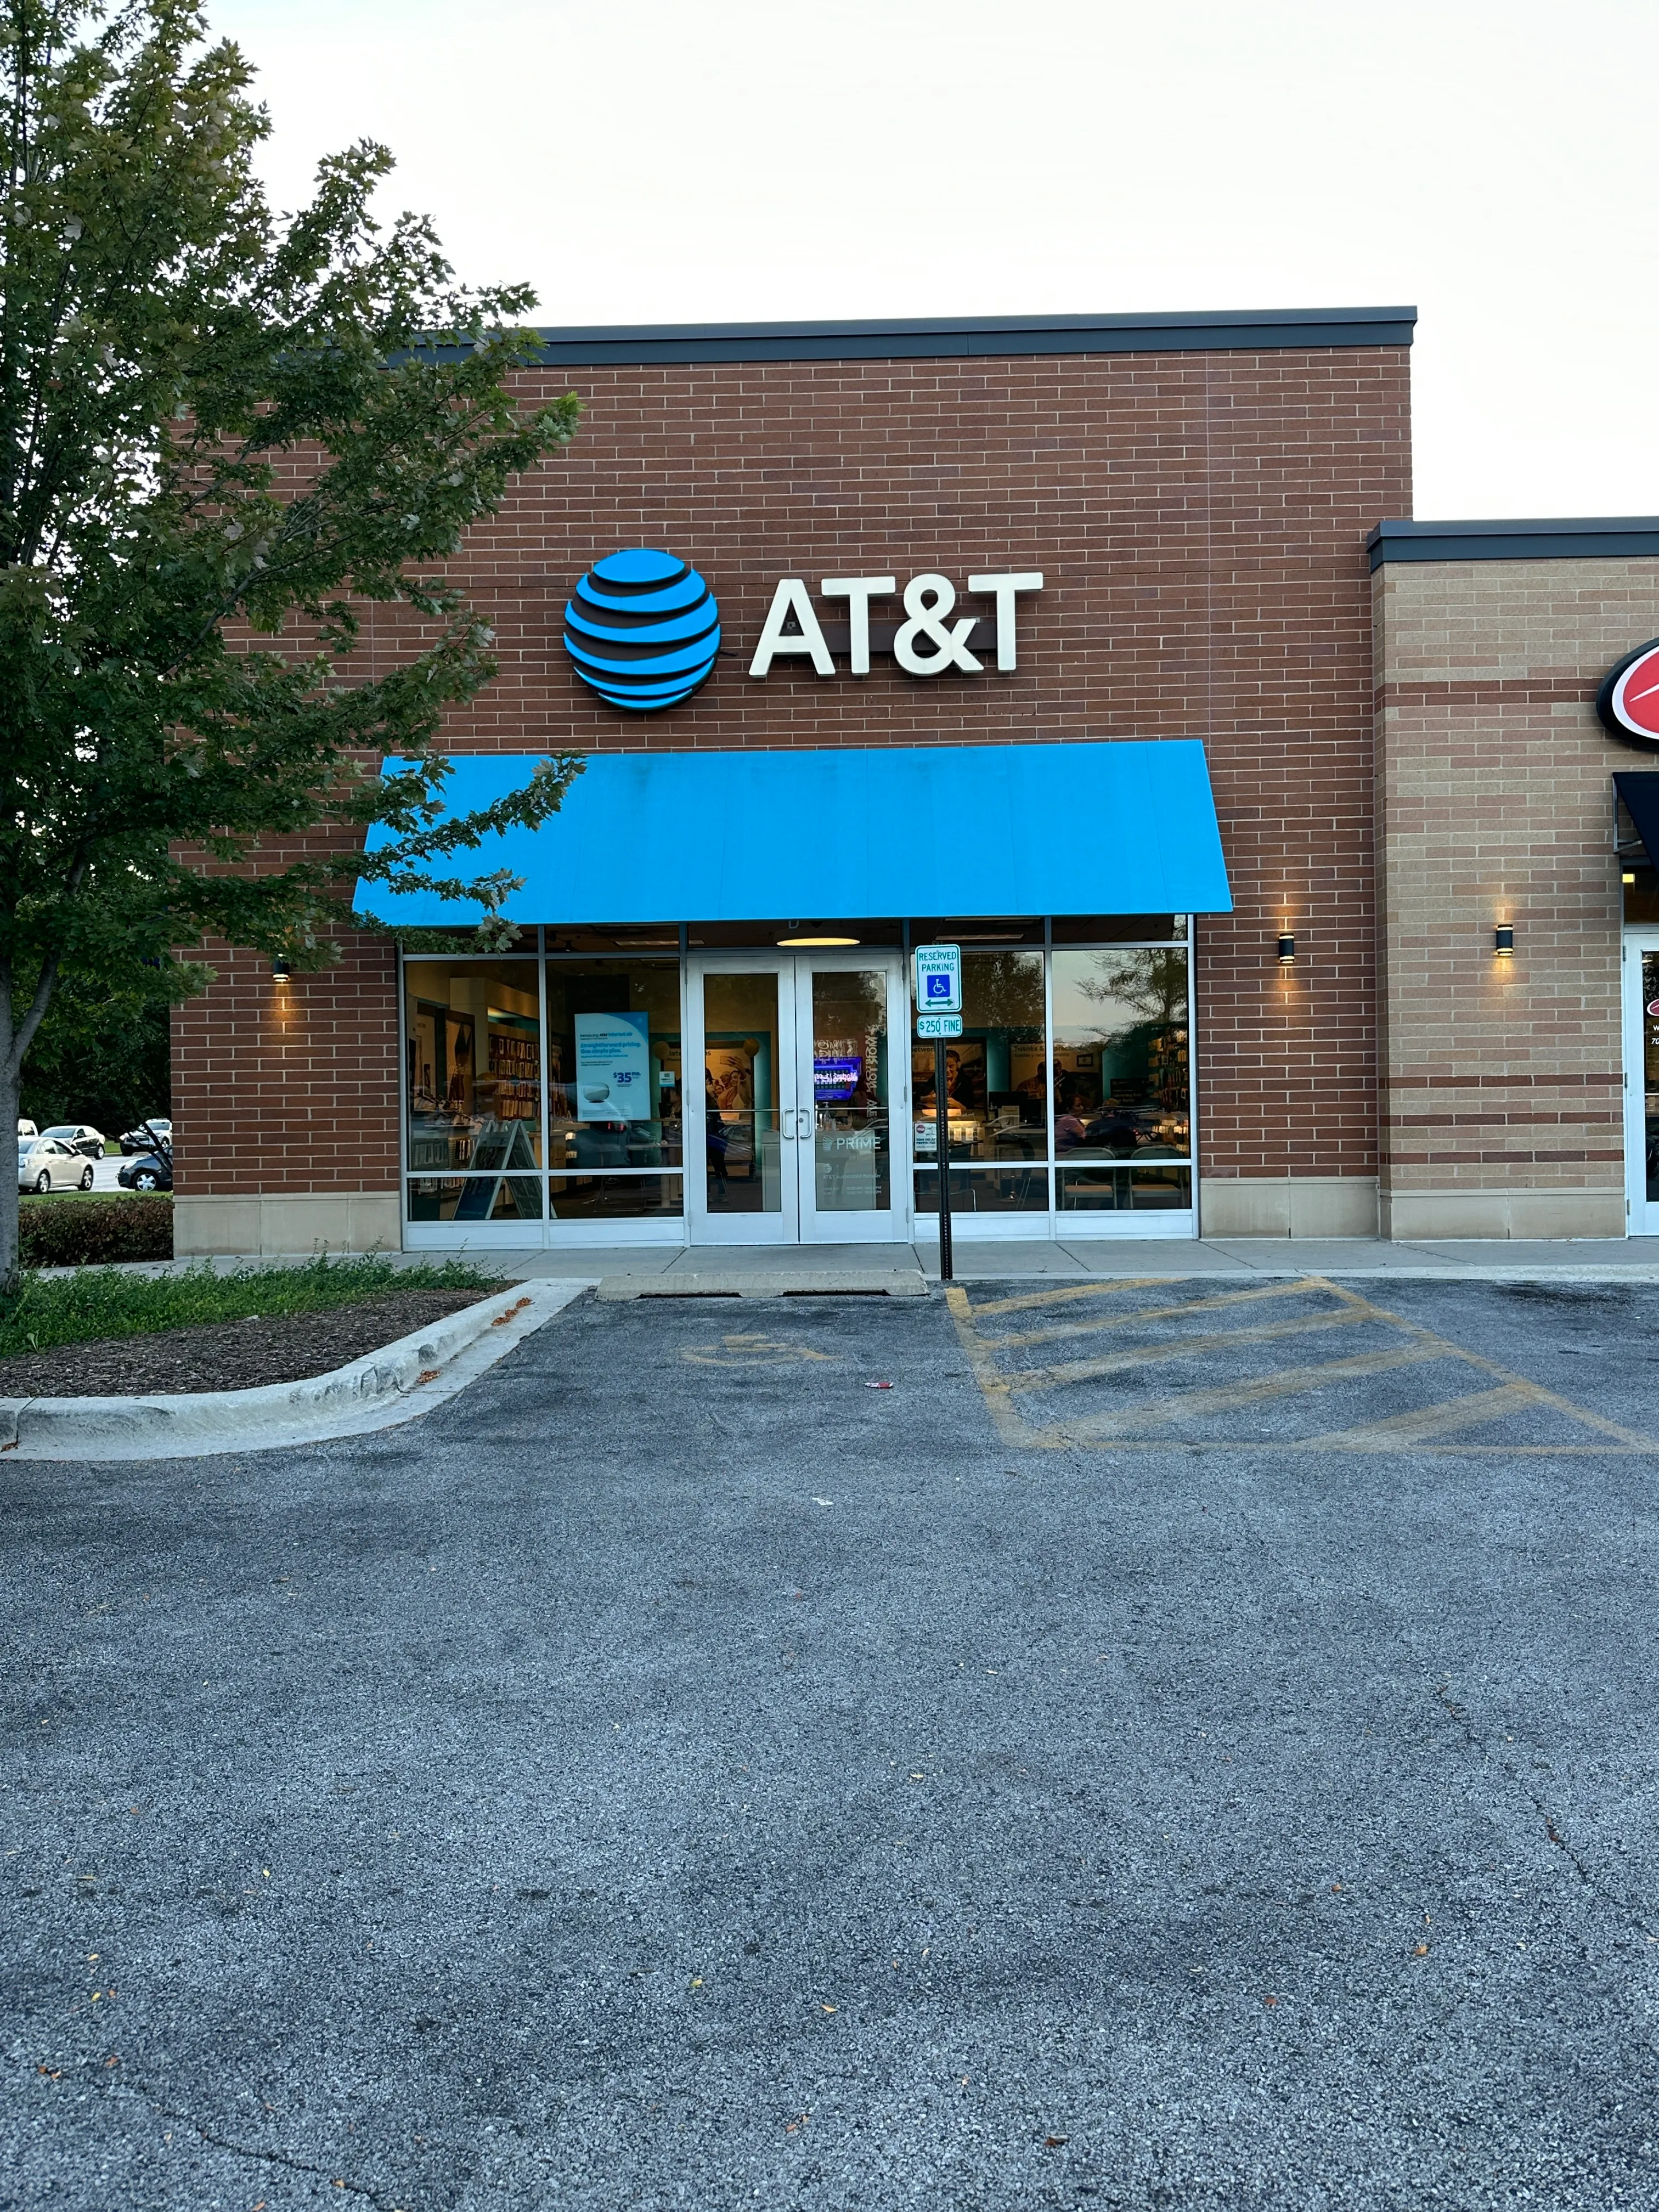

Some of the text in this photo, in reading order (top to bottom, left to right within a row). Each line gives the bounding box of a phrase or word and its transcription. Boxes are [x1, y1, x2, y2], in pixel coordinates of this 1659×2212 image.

[749, 572, 1043, 676] AT&T
[919, 951, 957, 961] RESERVED
[922, 963, 955, 972] PARKING
[944, 1020, 960, 1032] FINE
[837, 1137, 881, 1150] PRIME
